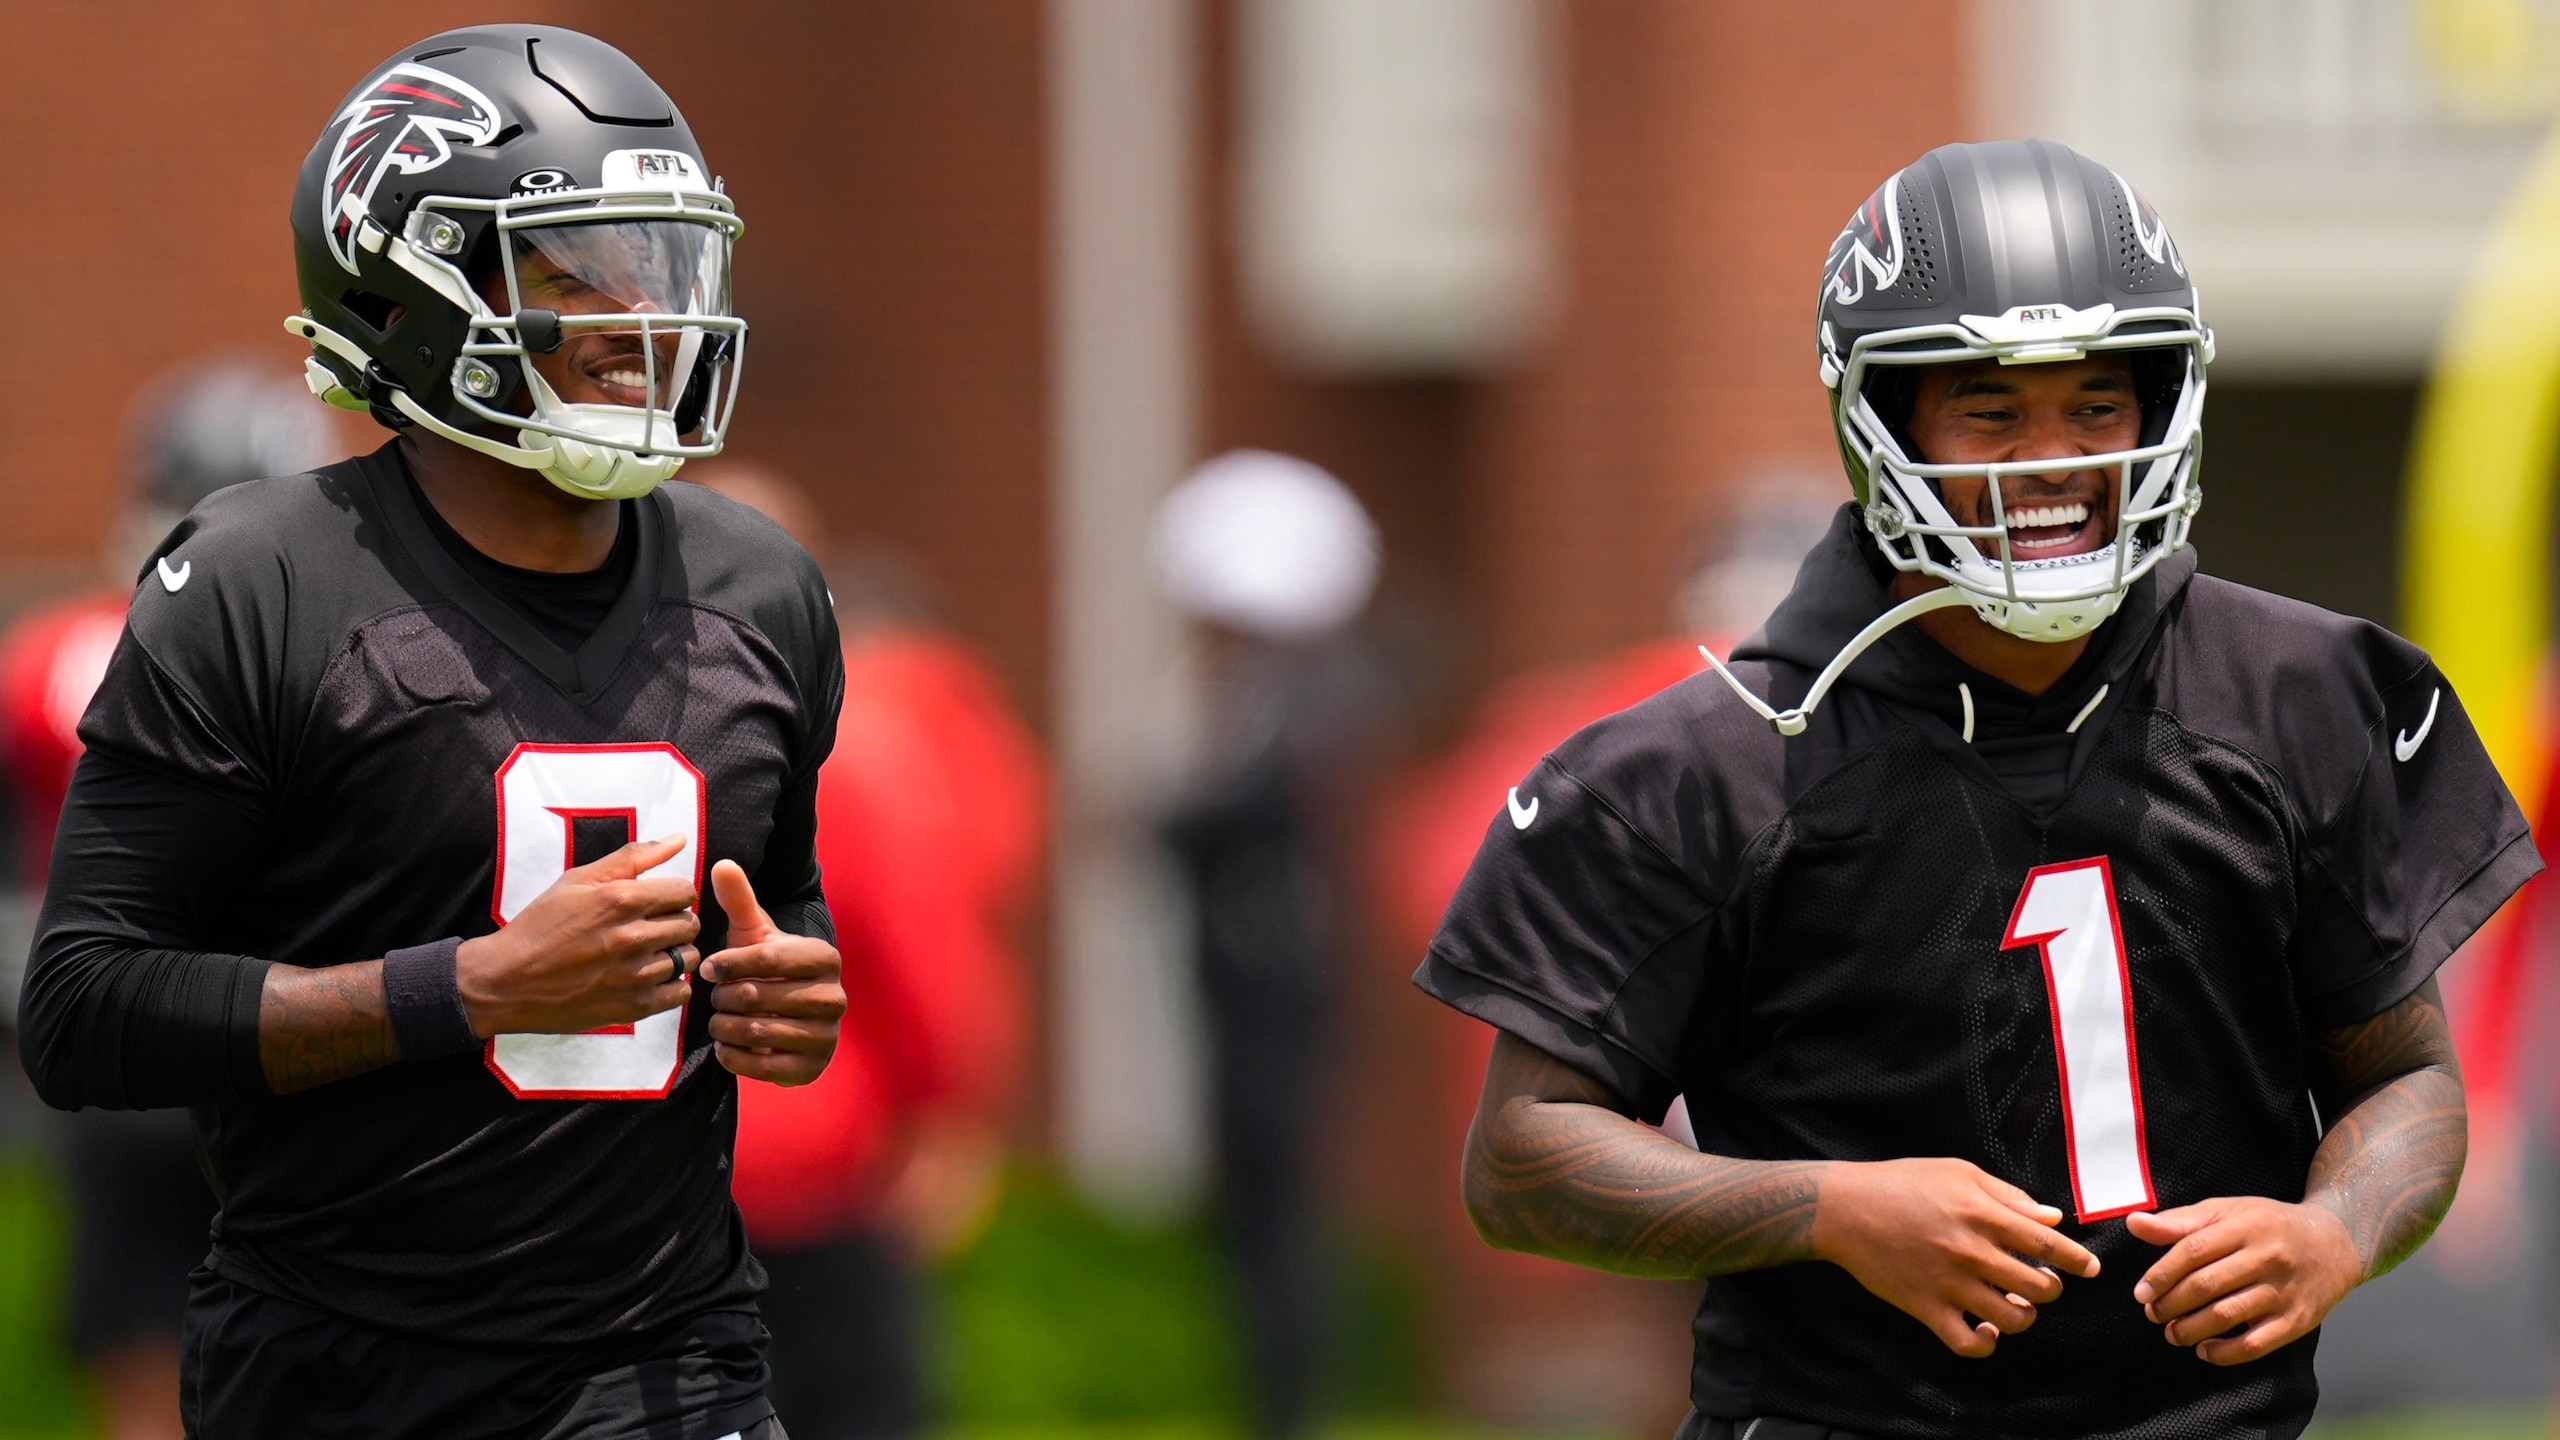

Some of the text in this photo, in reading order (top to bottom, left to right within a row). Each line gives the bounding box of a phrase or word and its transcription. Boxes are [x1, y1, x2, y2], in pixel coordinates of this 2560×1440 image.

[633, 153, 689, 178] ATL
[2020, 308, 2063, 323] ATL
[2000, 855, 2159, 1224] 1
